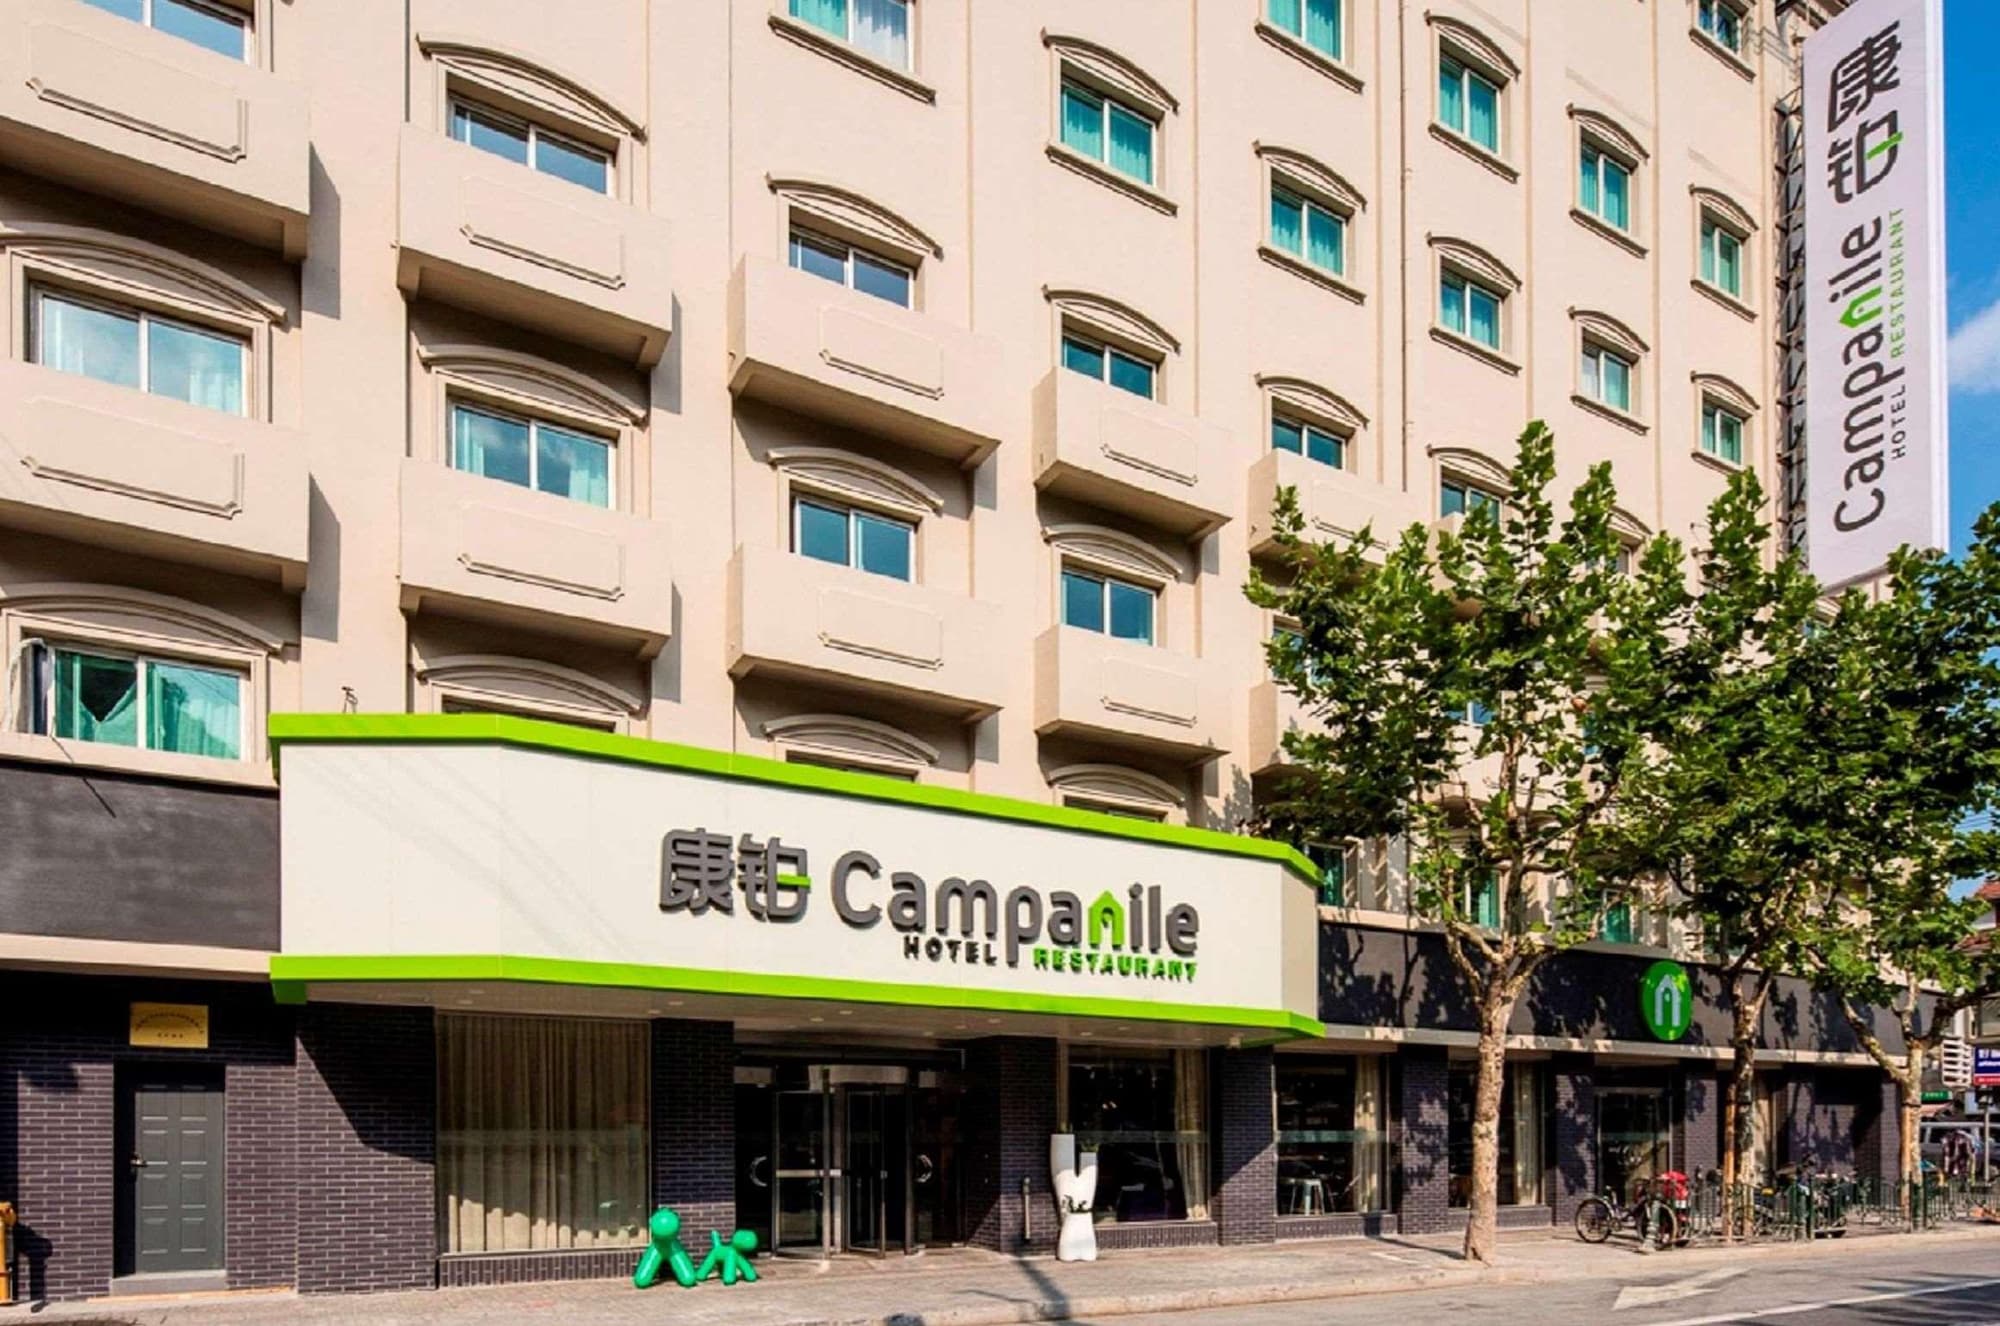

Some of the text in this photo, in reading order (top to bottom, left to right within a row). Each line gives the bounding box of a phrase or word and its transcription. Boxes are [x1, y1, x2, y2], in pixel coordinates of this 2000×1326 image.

[1828, 20, 1903, 204] 康铂
[1828, 216, 1906, 532] Campanile
[1889, 208, 1906, 460] HOTEL RESTAURANT
[659, 827, 811, 923] 康铂
[831, 850, 1200, 967] Campanile
[902, 935, 1198, 983] HOTEL RESTAURANT
